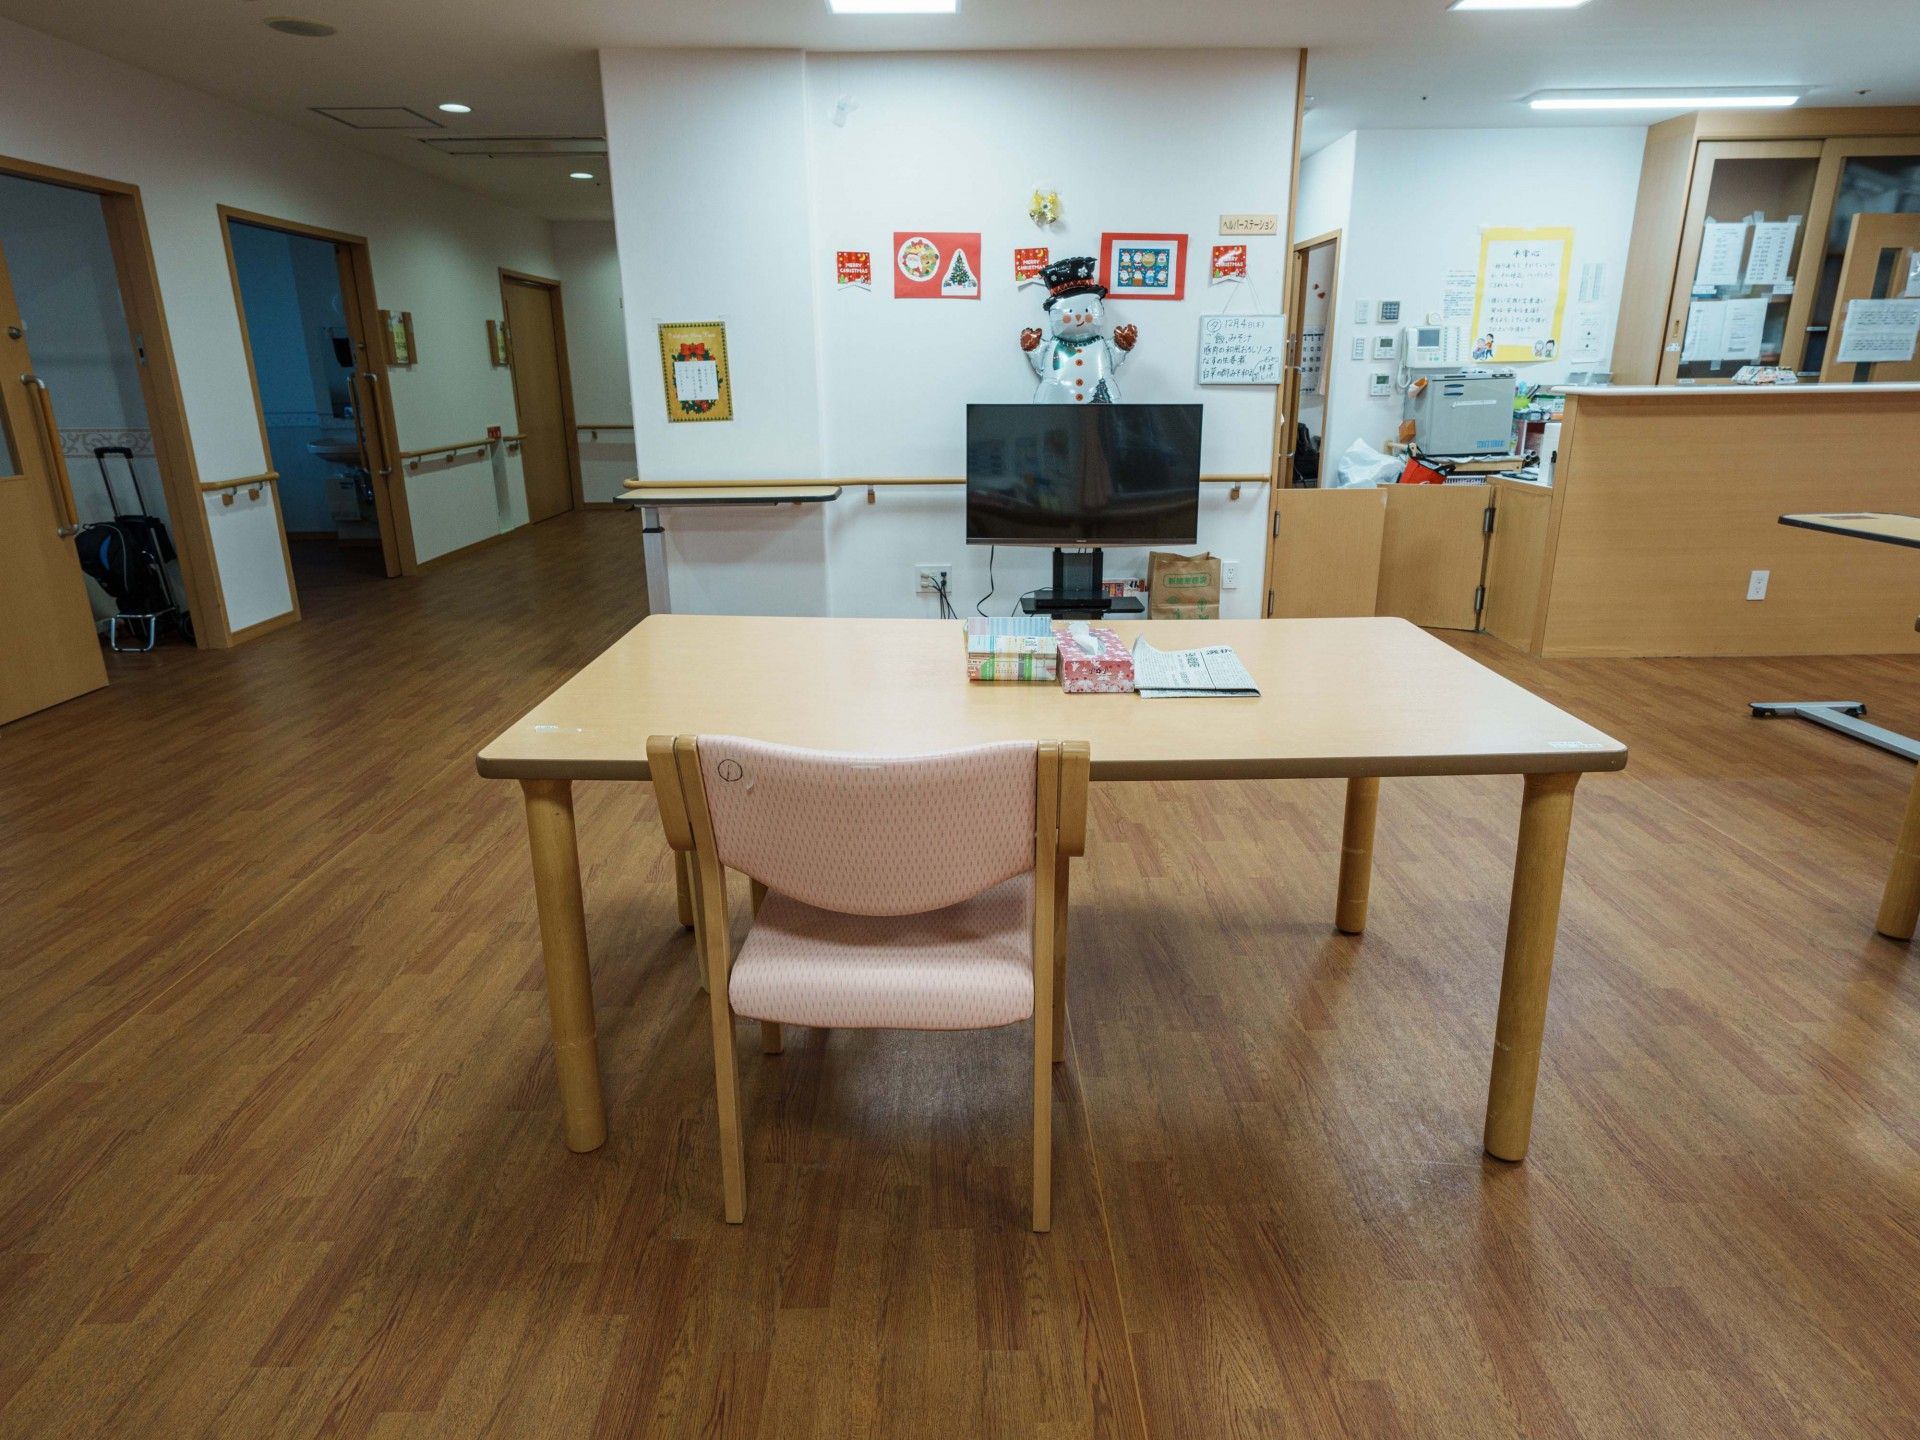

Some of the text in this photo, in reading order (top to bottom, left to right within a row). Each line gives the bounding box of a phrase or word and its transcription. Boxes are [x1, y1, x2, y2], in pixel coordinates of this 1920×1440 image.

[1223, 219, 1275, 230] ヘルパーステーション
